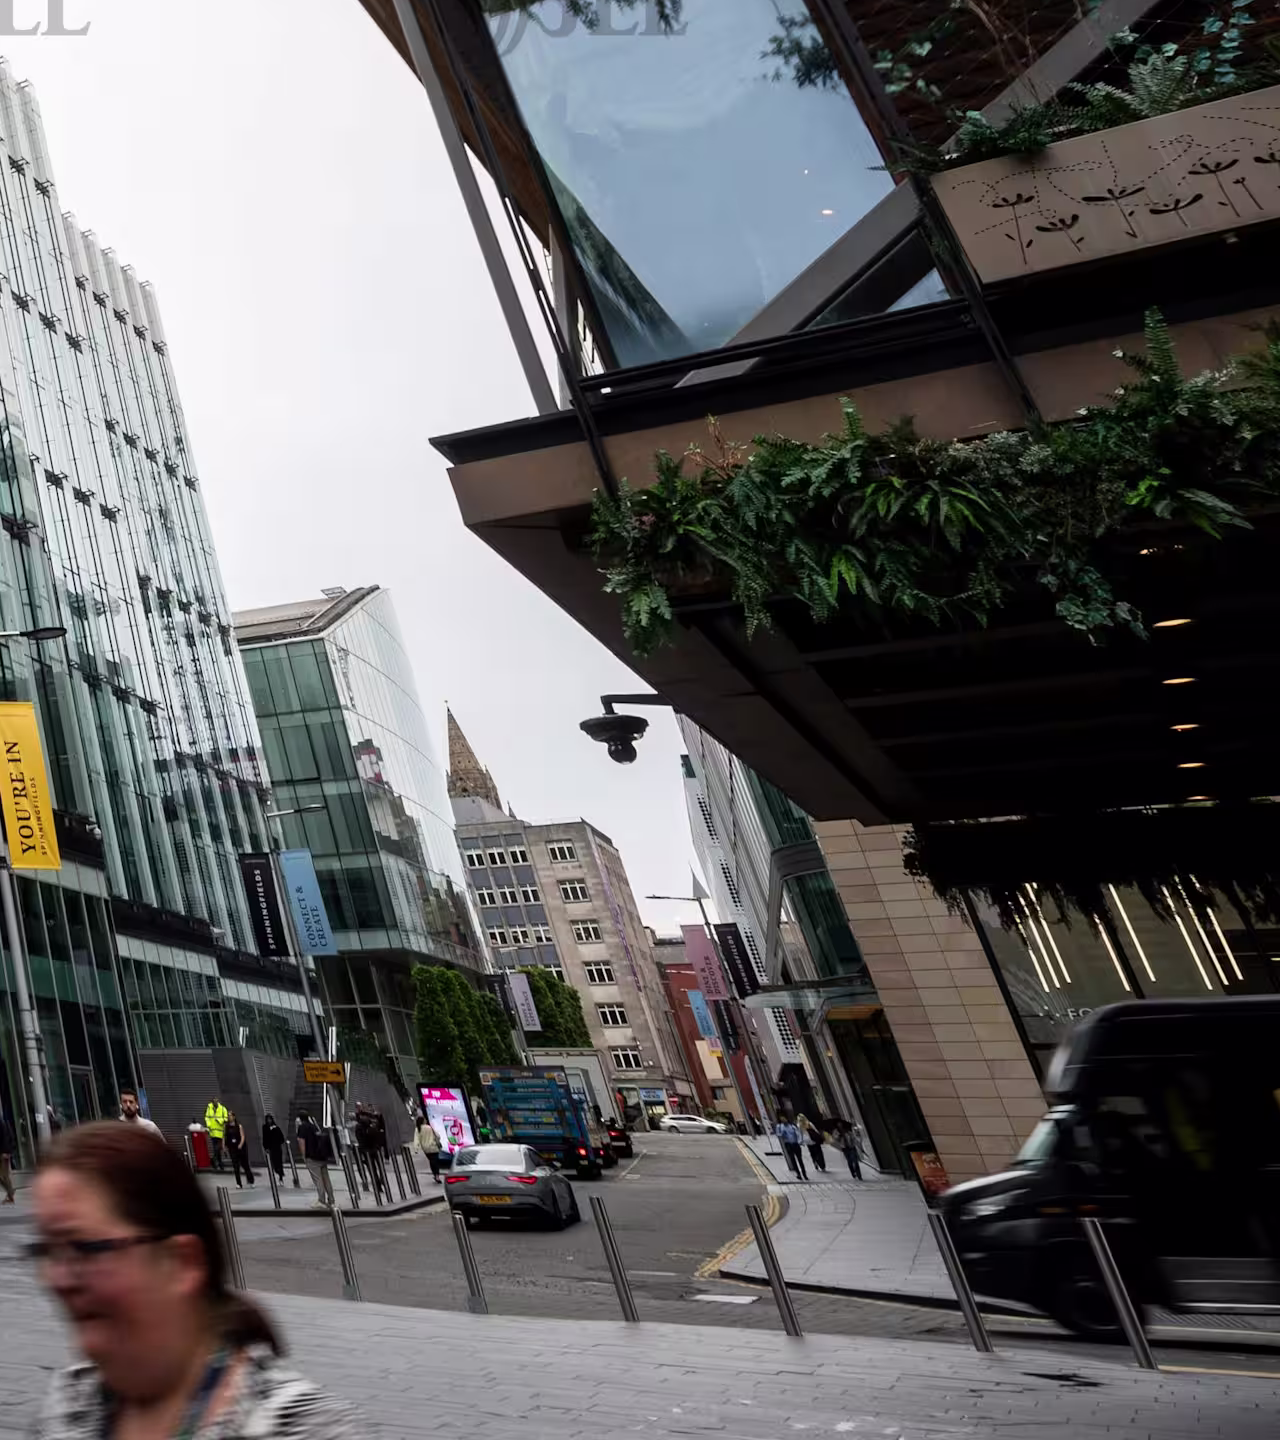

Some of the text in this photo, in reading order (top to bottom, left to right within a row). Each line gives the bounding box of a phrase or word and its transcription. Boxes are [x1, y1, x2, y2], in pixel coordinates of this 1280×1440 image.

[4, 740, 22, 764] IN
[10, 771, 37, 856] YOU'RE
[30, 777, 48, 856] SPINNINGFIELDS
[254, 869, 277, 950] SPINNINGFIELDS
[297, 897, 318, 948] CONNECT
[310, 905, 328, 947] CREATE
